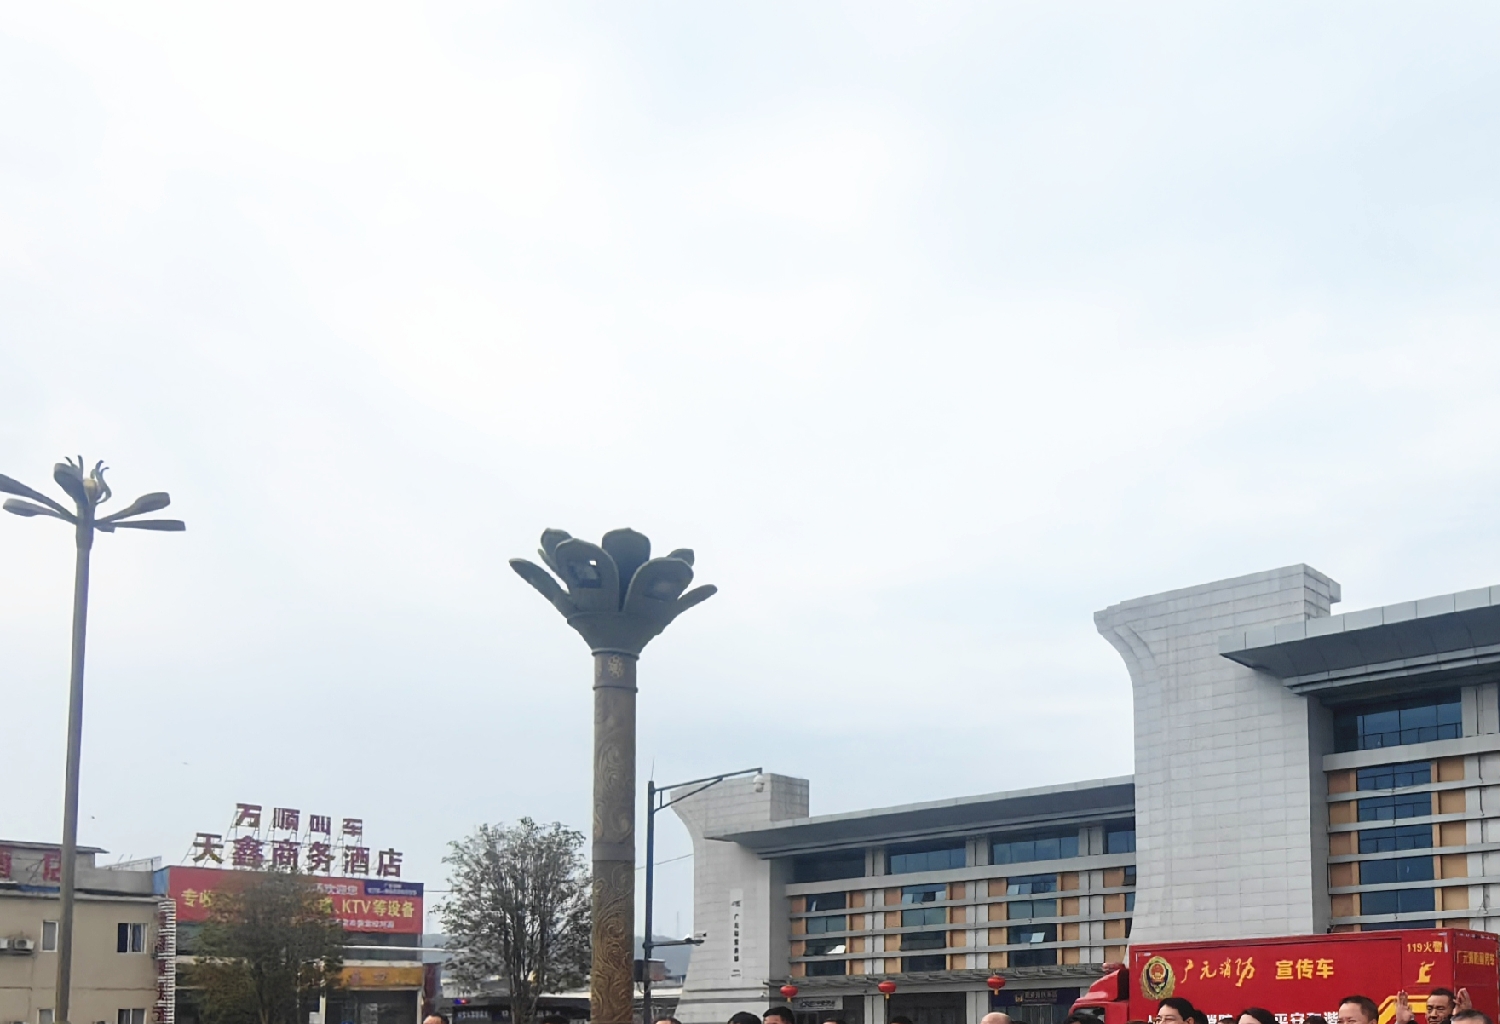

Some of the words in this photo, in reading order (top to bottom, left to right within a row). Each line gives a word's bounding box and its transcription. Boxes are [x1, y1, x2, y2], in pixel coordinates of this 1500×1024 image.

[235, 803, 363, 837] 万顺叫车
[192, 832, 403, 878] 天鑫商务酒店
[1180, 957, 1256, 987] 广元消防
[1275, 958, 1335, 980] 宣传车
